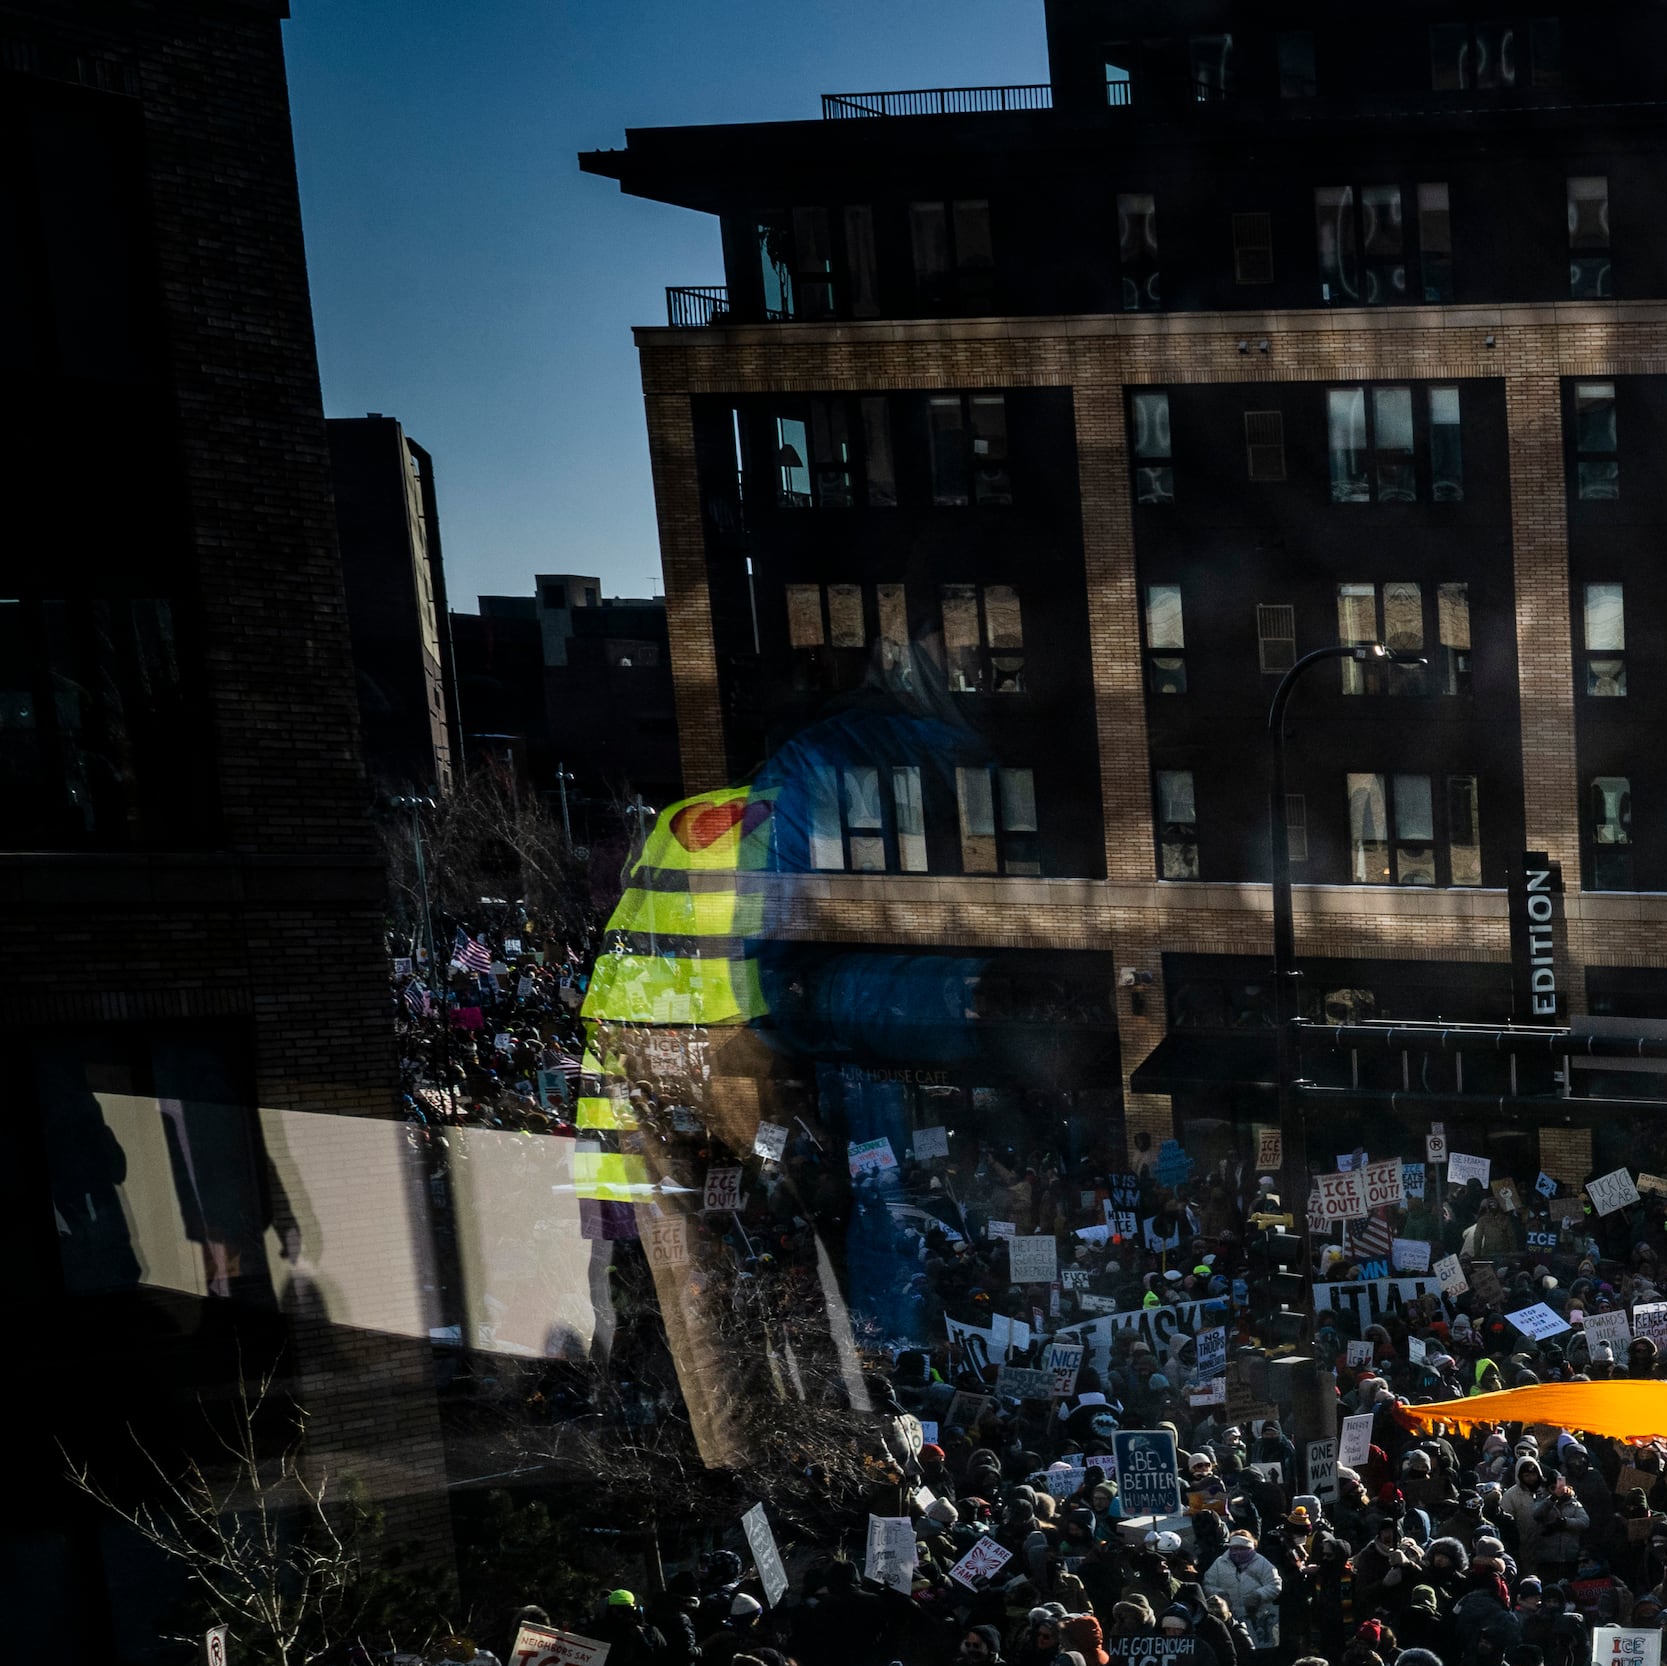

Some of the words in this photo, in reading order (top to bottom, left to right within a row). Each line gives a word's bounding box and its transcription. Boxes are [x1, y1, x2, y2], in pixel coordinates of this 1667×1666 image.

[1526, 870, 1558, 1016] EDITION
[1368, 1168, 1396, 1185] ICE
[1326, 1180, 1355, 1196] ICE
[1369, 1184, 1400, 1202] OUT!
[1326, 1197, 1360, 1214] OUT!
[1527, 1232, 1556, 1246] ICE
[1135, 1452, 1157, 1470] BE
[1311, 1445, 1333, 1460] ONE
[1311, 1462, 1333, 1478] WAY
[1124, 1473, 1174, 1491] BETTER
[1124, 1492, 1175, 1507] HUMANS
[521, 1636, 572, 1658] NEIGHBORS
[575, 1651, 592, 1662] SAY
[1111, 1639, 1130, 1656] WE
[1130, 1638, 1152, 1656] GOT
[1152, 1636, 1195, 1654] ENOUGH
